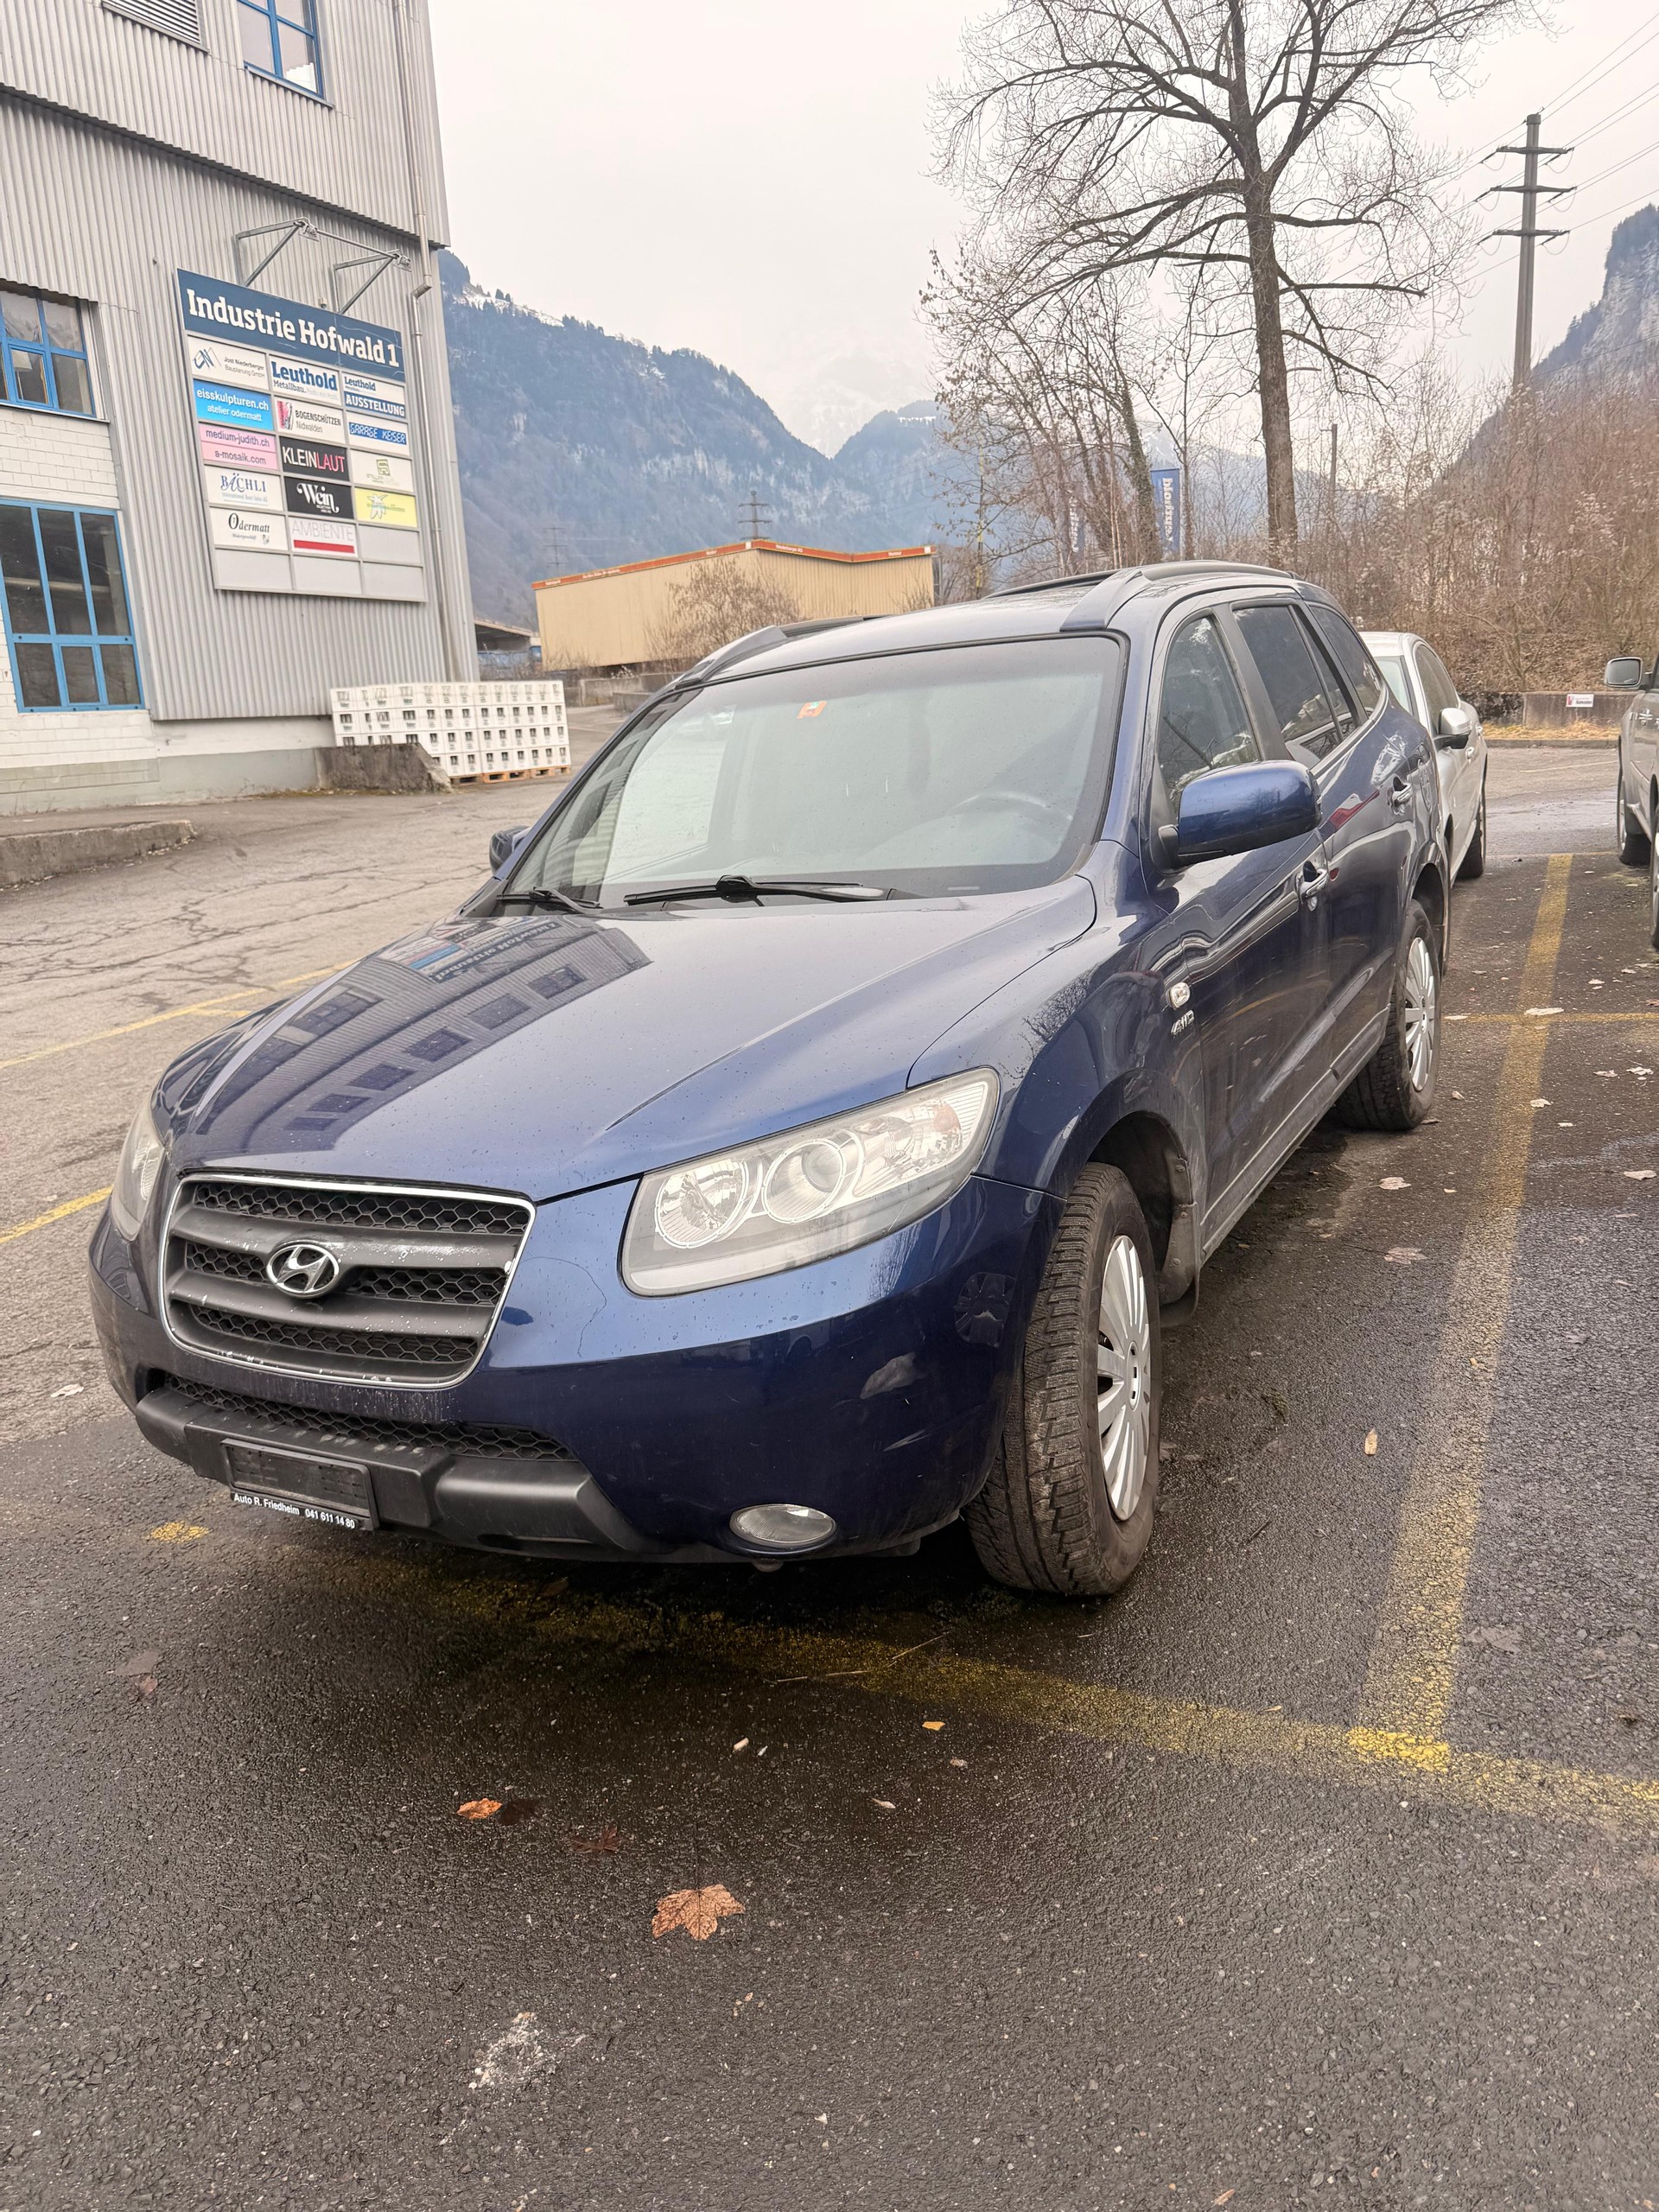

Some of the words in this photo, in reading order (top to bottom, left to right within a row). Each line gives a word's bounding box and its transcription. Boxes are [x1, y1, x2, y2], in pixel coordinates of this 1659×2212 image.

[187, 289, 296, 341] Industrie
[298, 319, 386, 365] Hofwald
[387, 343, 400, 368] 1
[271, 360, 338, 391] Leuthold
[344, 376, 376, 391] Leuthold
[196, 388, 269, 411] eisskulpturen.ch
[346, 394, 405, 417] AUSSTELLUNG
[207, 404, 230, 415] atelier
[231, 408, 263, 422] odermatt
[295, 410, 341, 426] BOGENSCHÜTZEN
[206, 429, 270, 448] medium-judith.ch
[350, 423, 378, 439] GARAGE
[214, 450, 267, 465] a-mosaik.com
[282, 446, 345, 473] KLEINLAUT
[220, 472, 266, 493] BÄCHLI
[296, 482, 340, 513] Wein
[228, 512, 270, 533] Odermatt
[292, 520, 355, 542] AMBIENTE
[233, 1493, 252, 1504] Auto
[253, 1497, 263, 1507] R.
[264, 1498, 301, 1516] Friedheim
[304, 1508, 319, 1520] 041
[320, 1511, 334, 1522] 611
[334, 1515, 345, 1525] 14
[345, 1518, 355, 1529] 80
